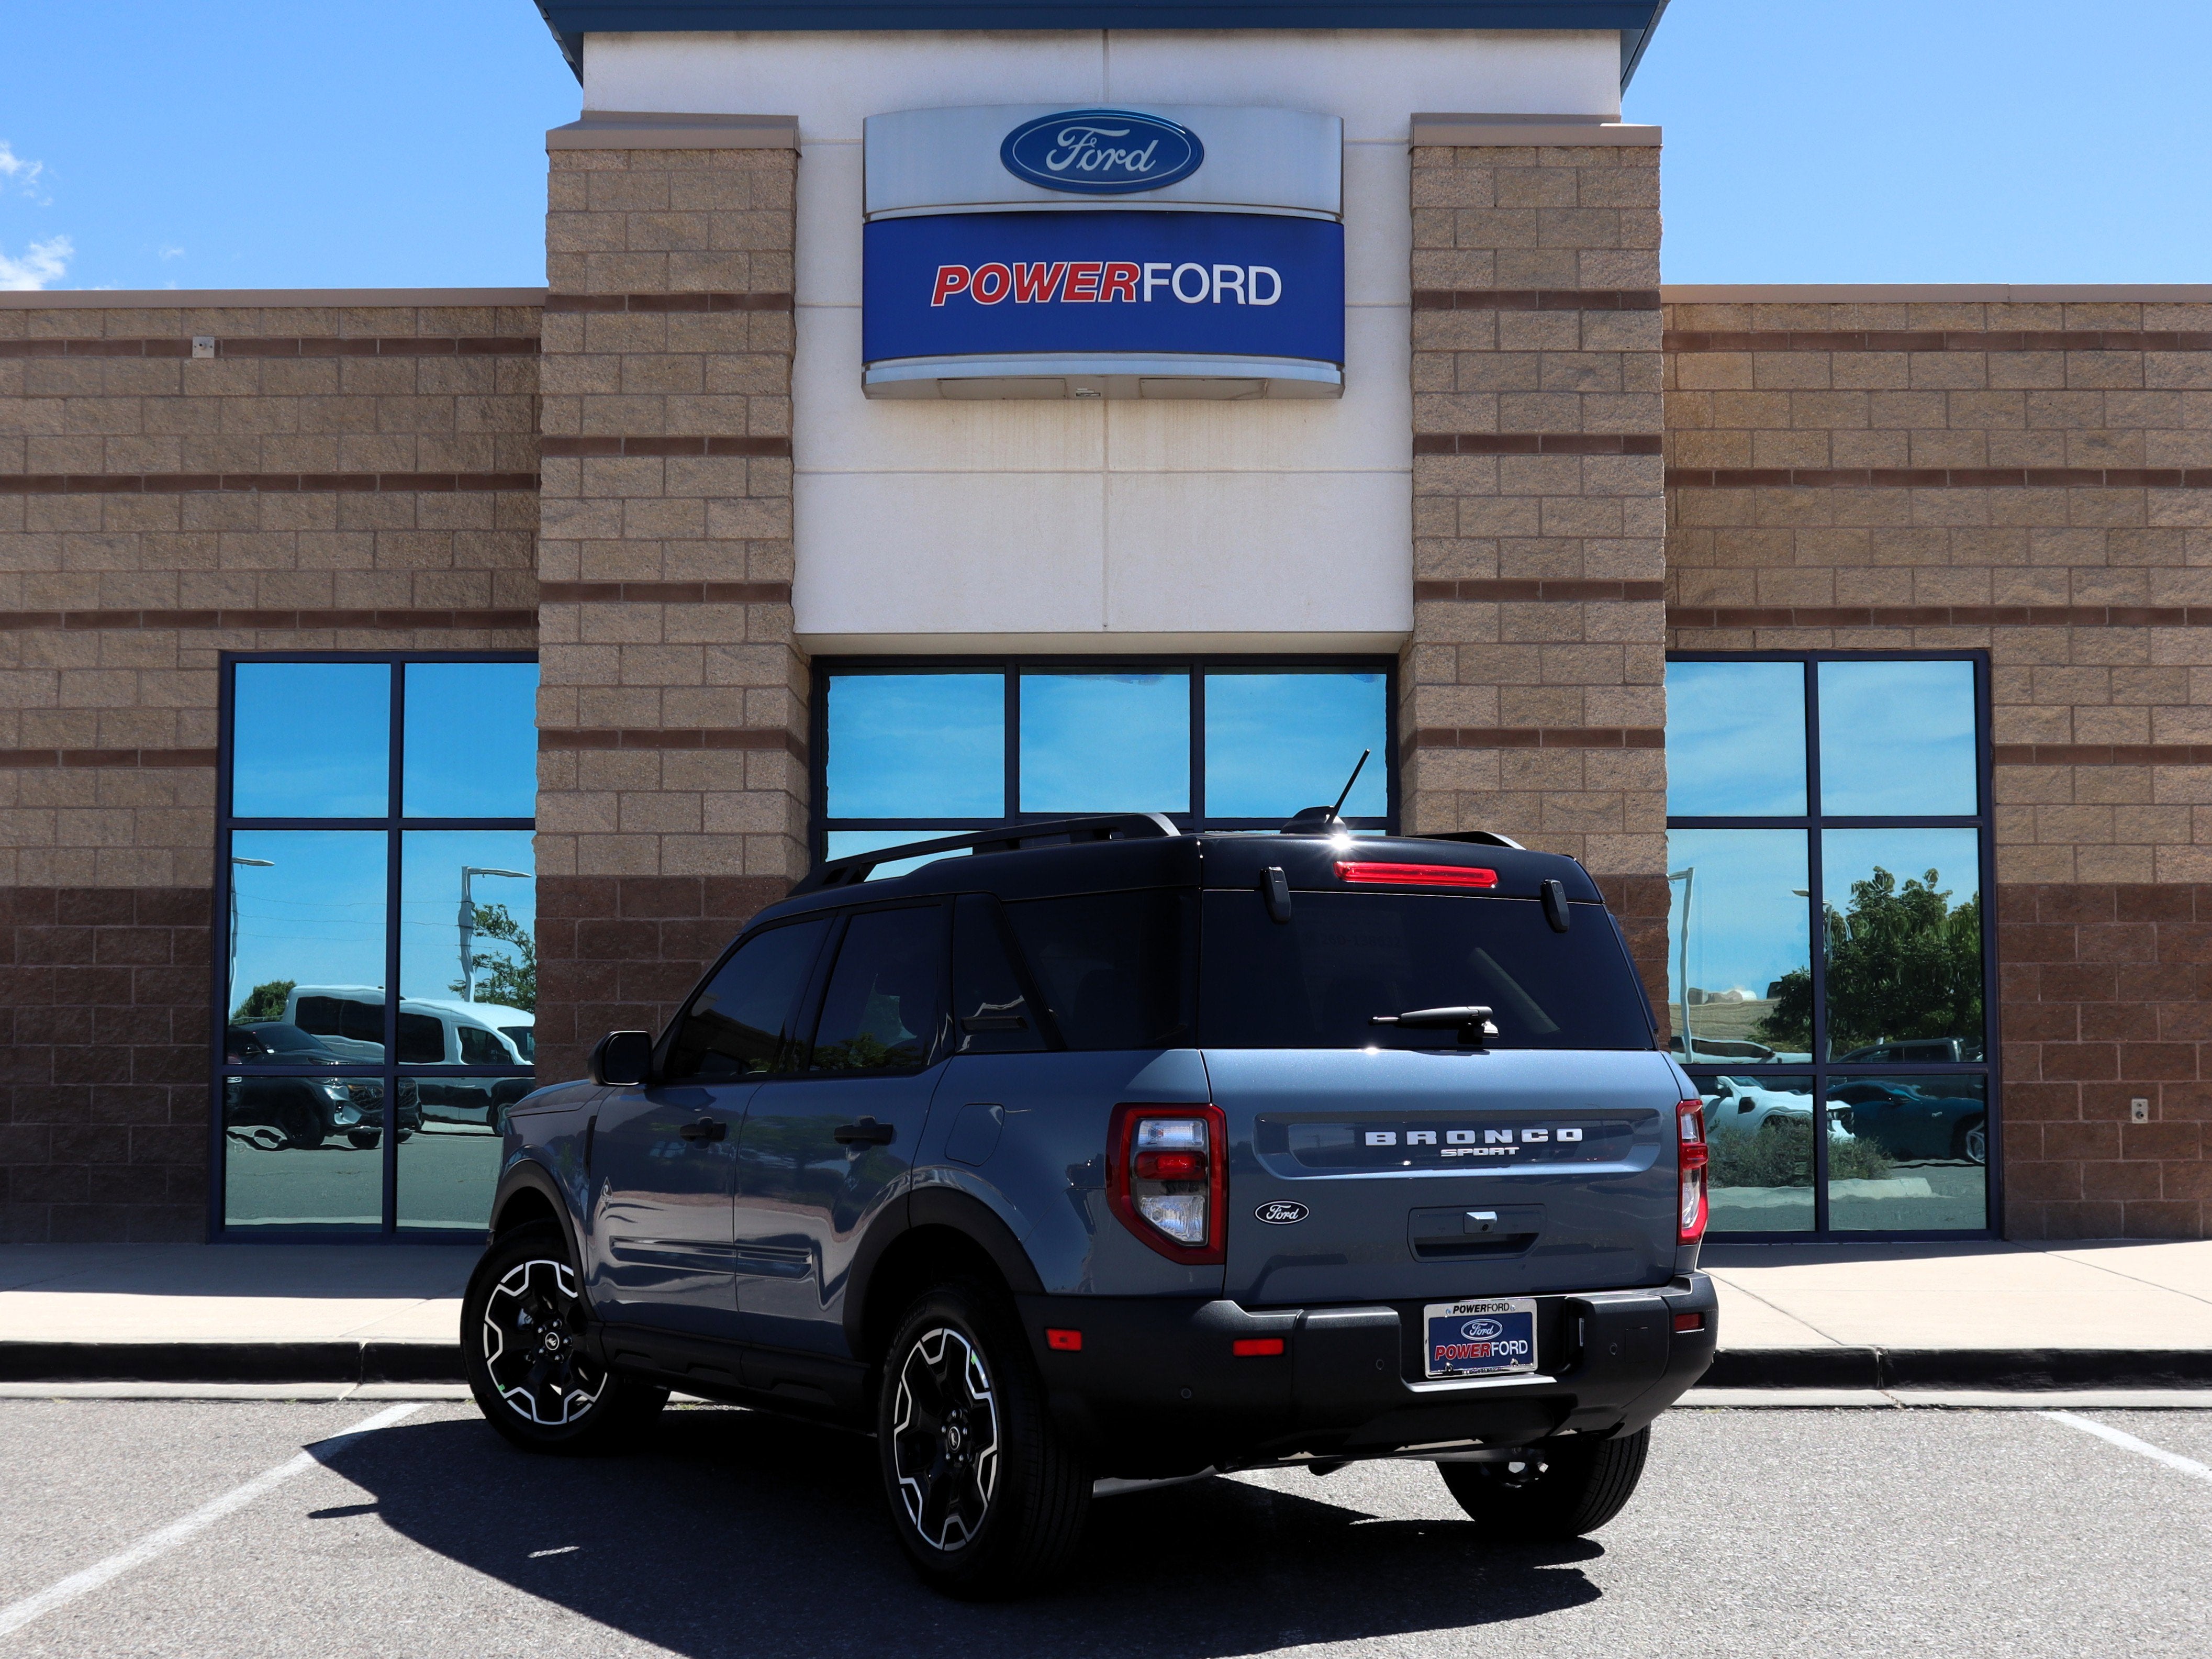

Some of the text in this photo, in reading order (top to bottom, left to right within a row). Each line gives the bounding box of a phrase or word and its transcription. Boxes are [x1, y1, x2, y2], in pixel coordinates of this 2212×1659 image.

[1046, 126, 1158, 172] Ford
[931, 261, 1282, 307] POWERFORD
[1365, 1128, 1583, 1146] BRONCO
[1440, 1147, 1520, 1157] SPORT
[1266, 1204, 1300, 1220] Ford
[1453, 1303, 1510, 1314] POWERFORD
[1469, 1323, 1494, 1336] Ford
[1434, 1340, 1528, 1361] POWERFORD
